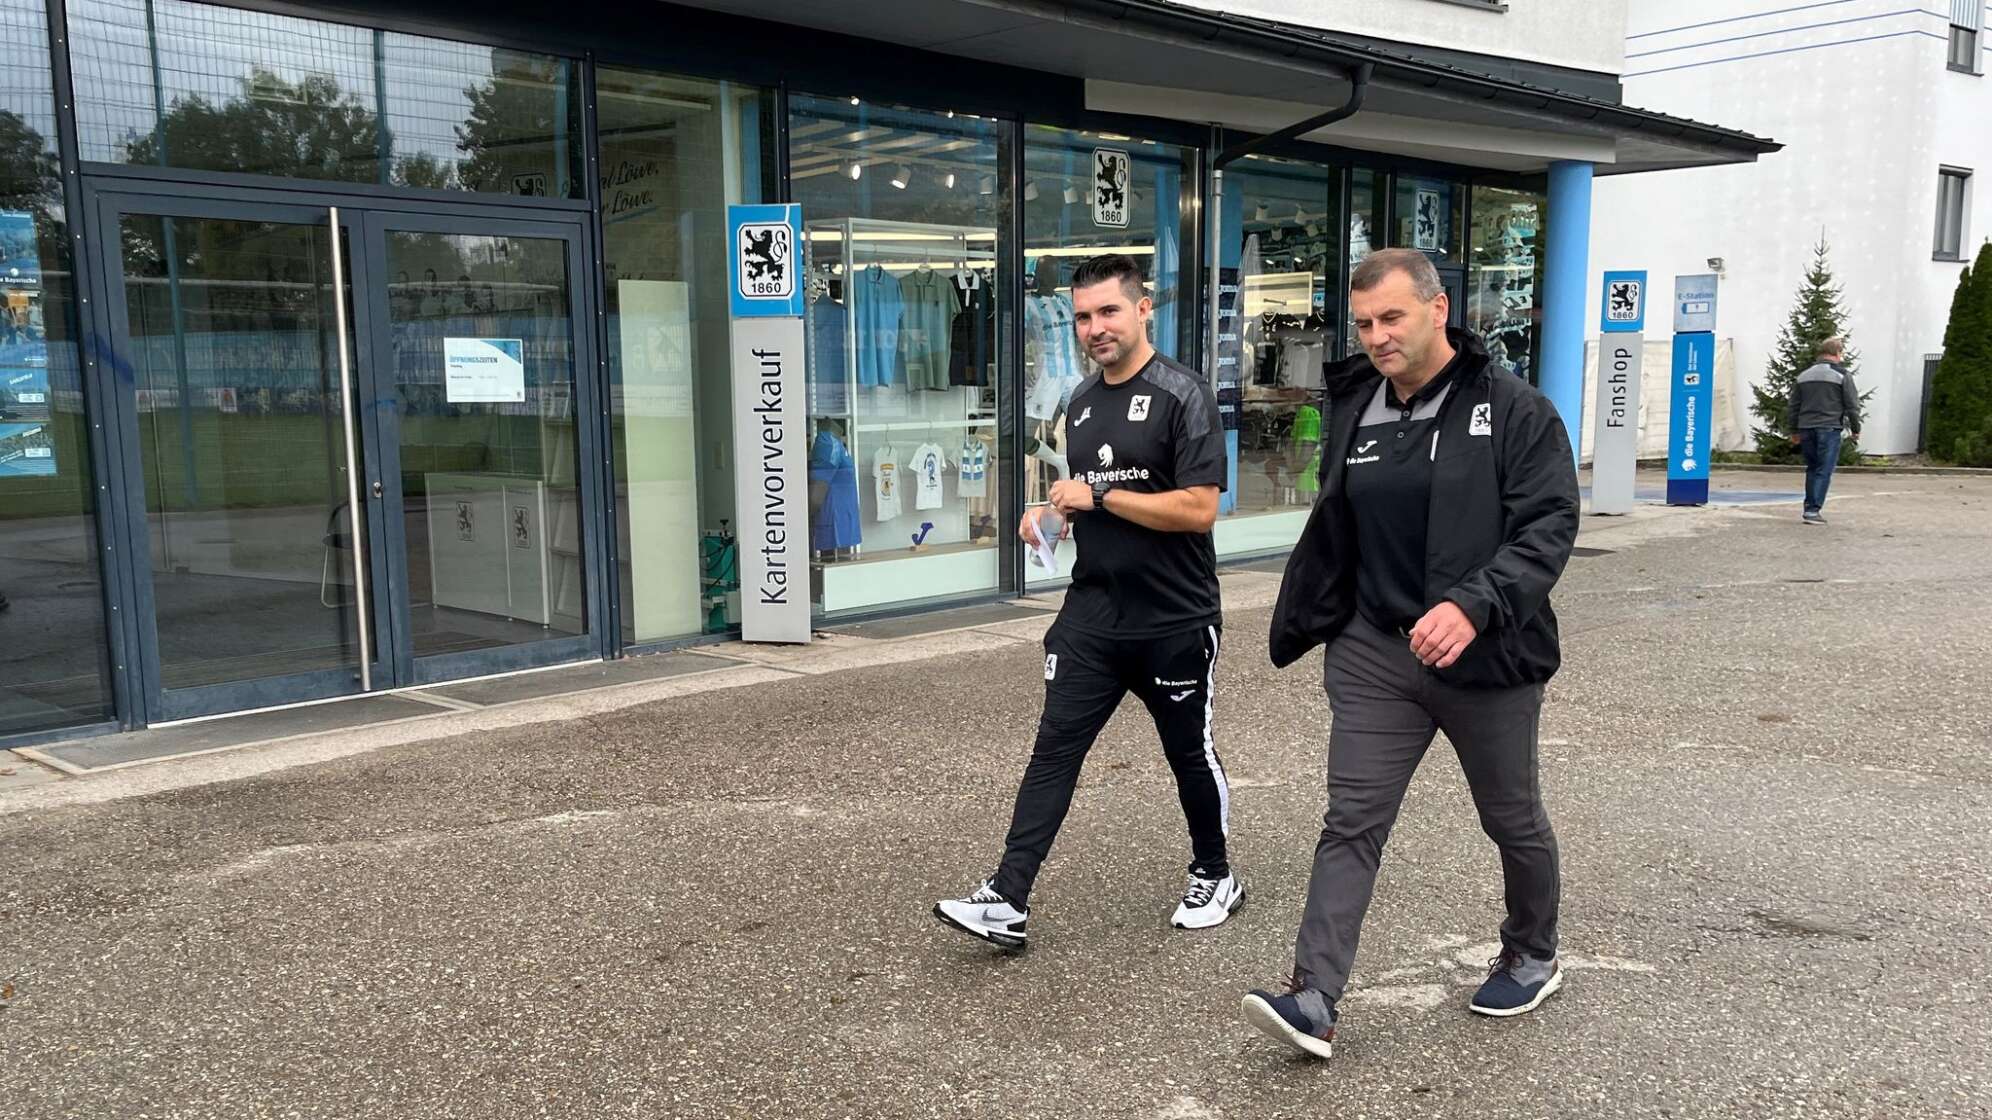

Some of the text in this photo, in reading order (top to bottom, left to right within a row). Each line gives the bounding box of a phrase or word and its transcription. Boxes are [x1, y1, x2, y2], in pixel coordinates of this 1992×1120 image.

[1101, 210, 1121, 222] 1860
[752, 282, 781, 293] 1860
[1612, 311, 1633, 319] 1860
[1607, 348, 1632, 428] Fanshop
[1685, 396, 1697, 442] Bayerische
[752, 348, 787, 604] Kartenvorverkauf
